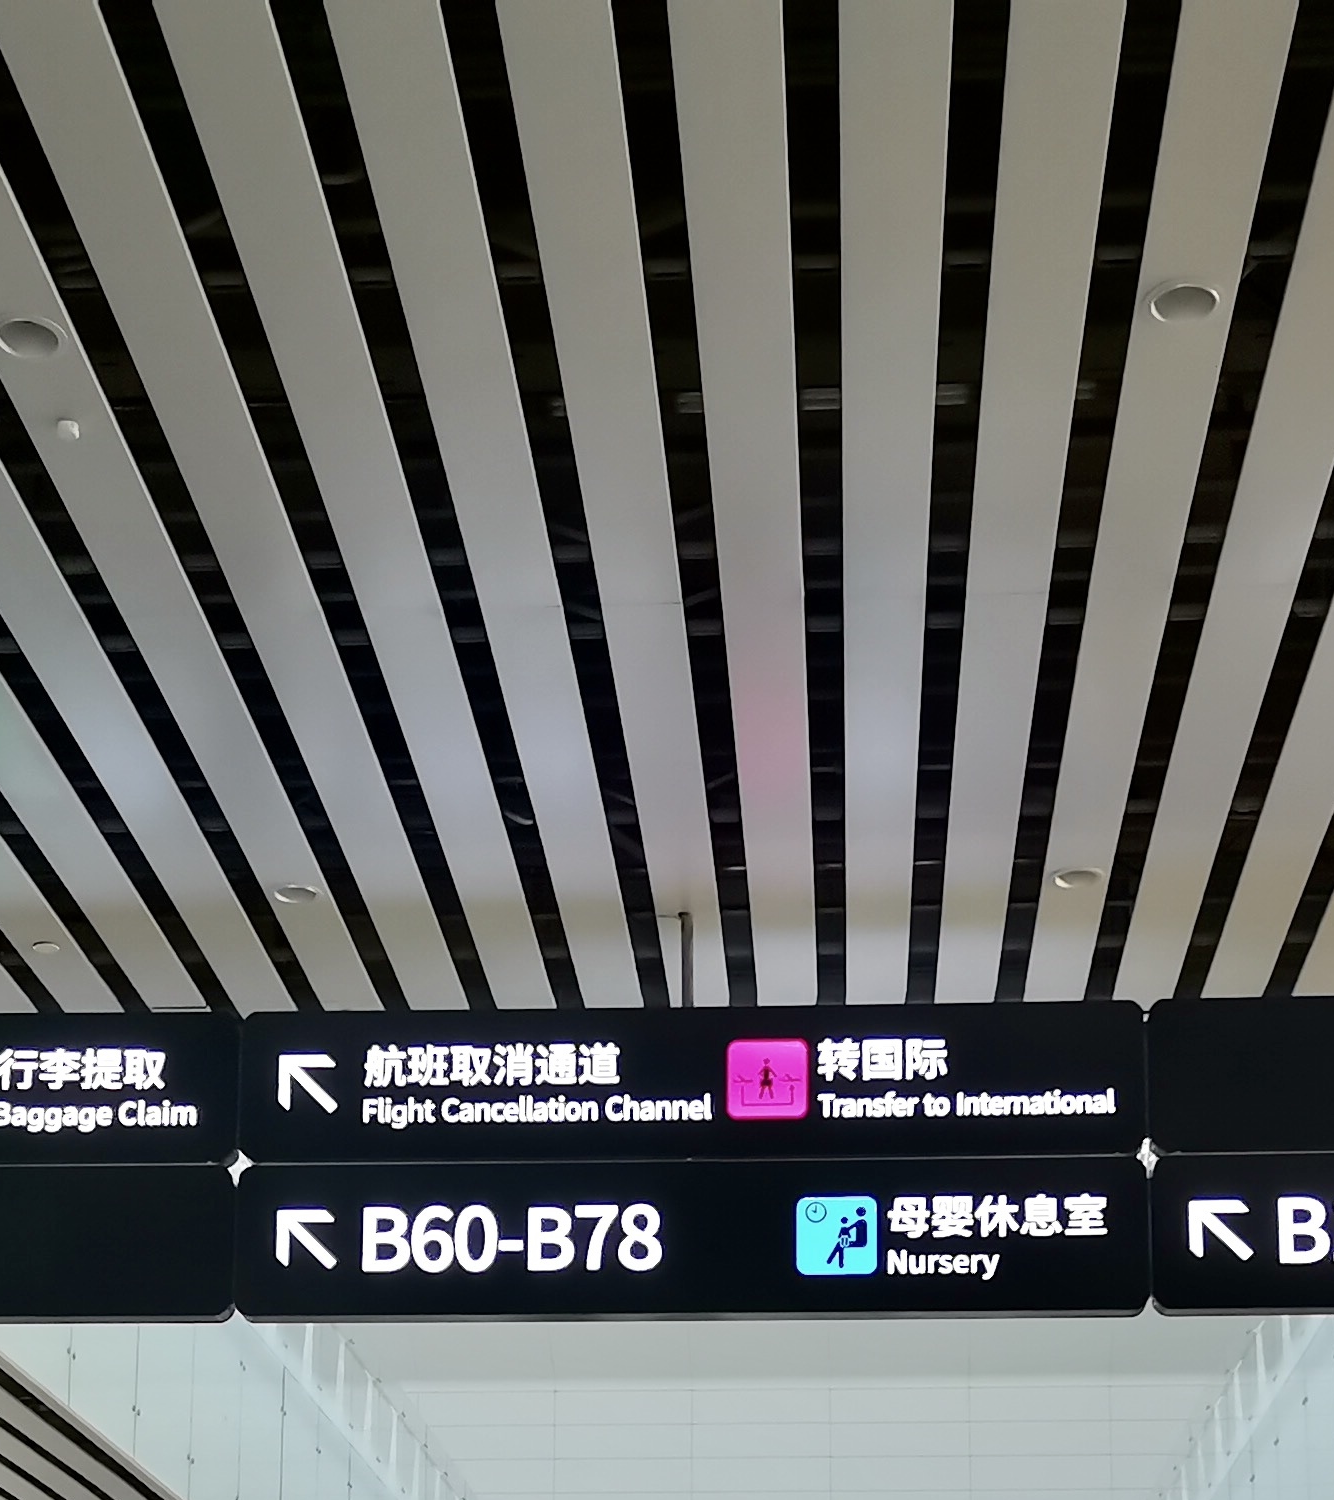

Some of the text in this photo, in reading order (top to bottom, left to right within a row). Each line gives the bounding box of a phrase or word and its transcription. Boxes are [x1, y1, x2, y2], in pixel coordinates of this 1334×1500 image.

[364, 1042, 621, 1088] 航班取消通道
[817, 1037, 948, 1081] 转国际
[118, 1099, 198, 1128] Claim
[362, 1093, 712, 1130] Flight Cancellation Channel
[817, 1087, 1117, 1118] Transfer to International
[886, 1193, 1109, 1238] 母婴休息室
[361, 1203, 663, 1273] B60-B78
[887, 1249, 1000, 1281] Nursery
